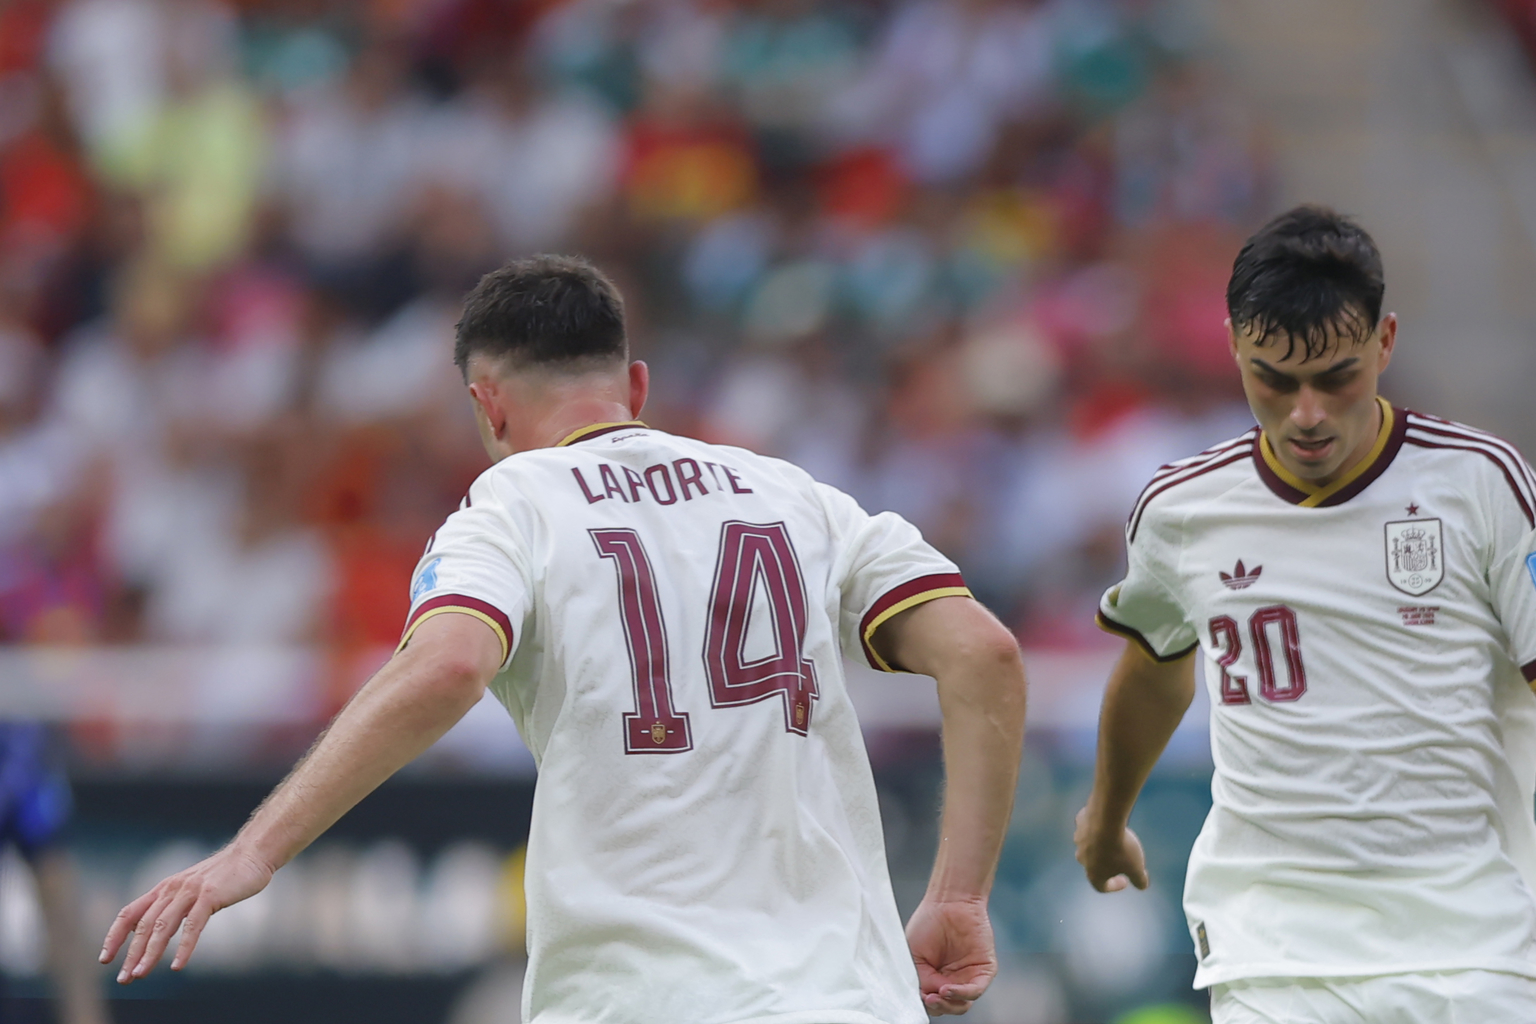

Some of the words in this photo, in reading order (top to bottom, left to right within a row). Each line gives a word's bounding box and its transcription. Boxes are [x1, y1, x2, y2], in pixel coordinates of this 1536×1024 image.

[571, 457, 754, 506] LAPORTE
[587, 519, 820, 755] 14
[1208, 603, 1308, 706] 20
